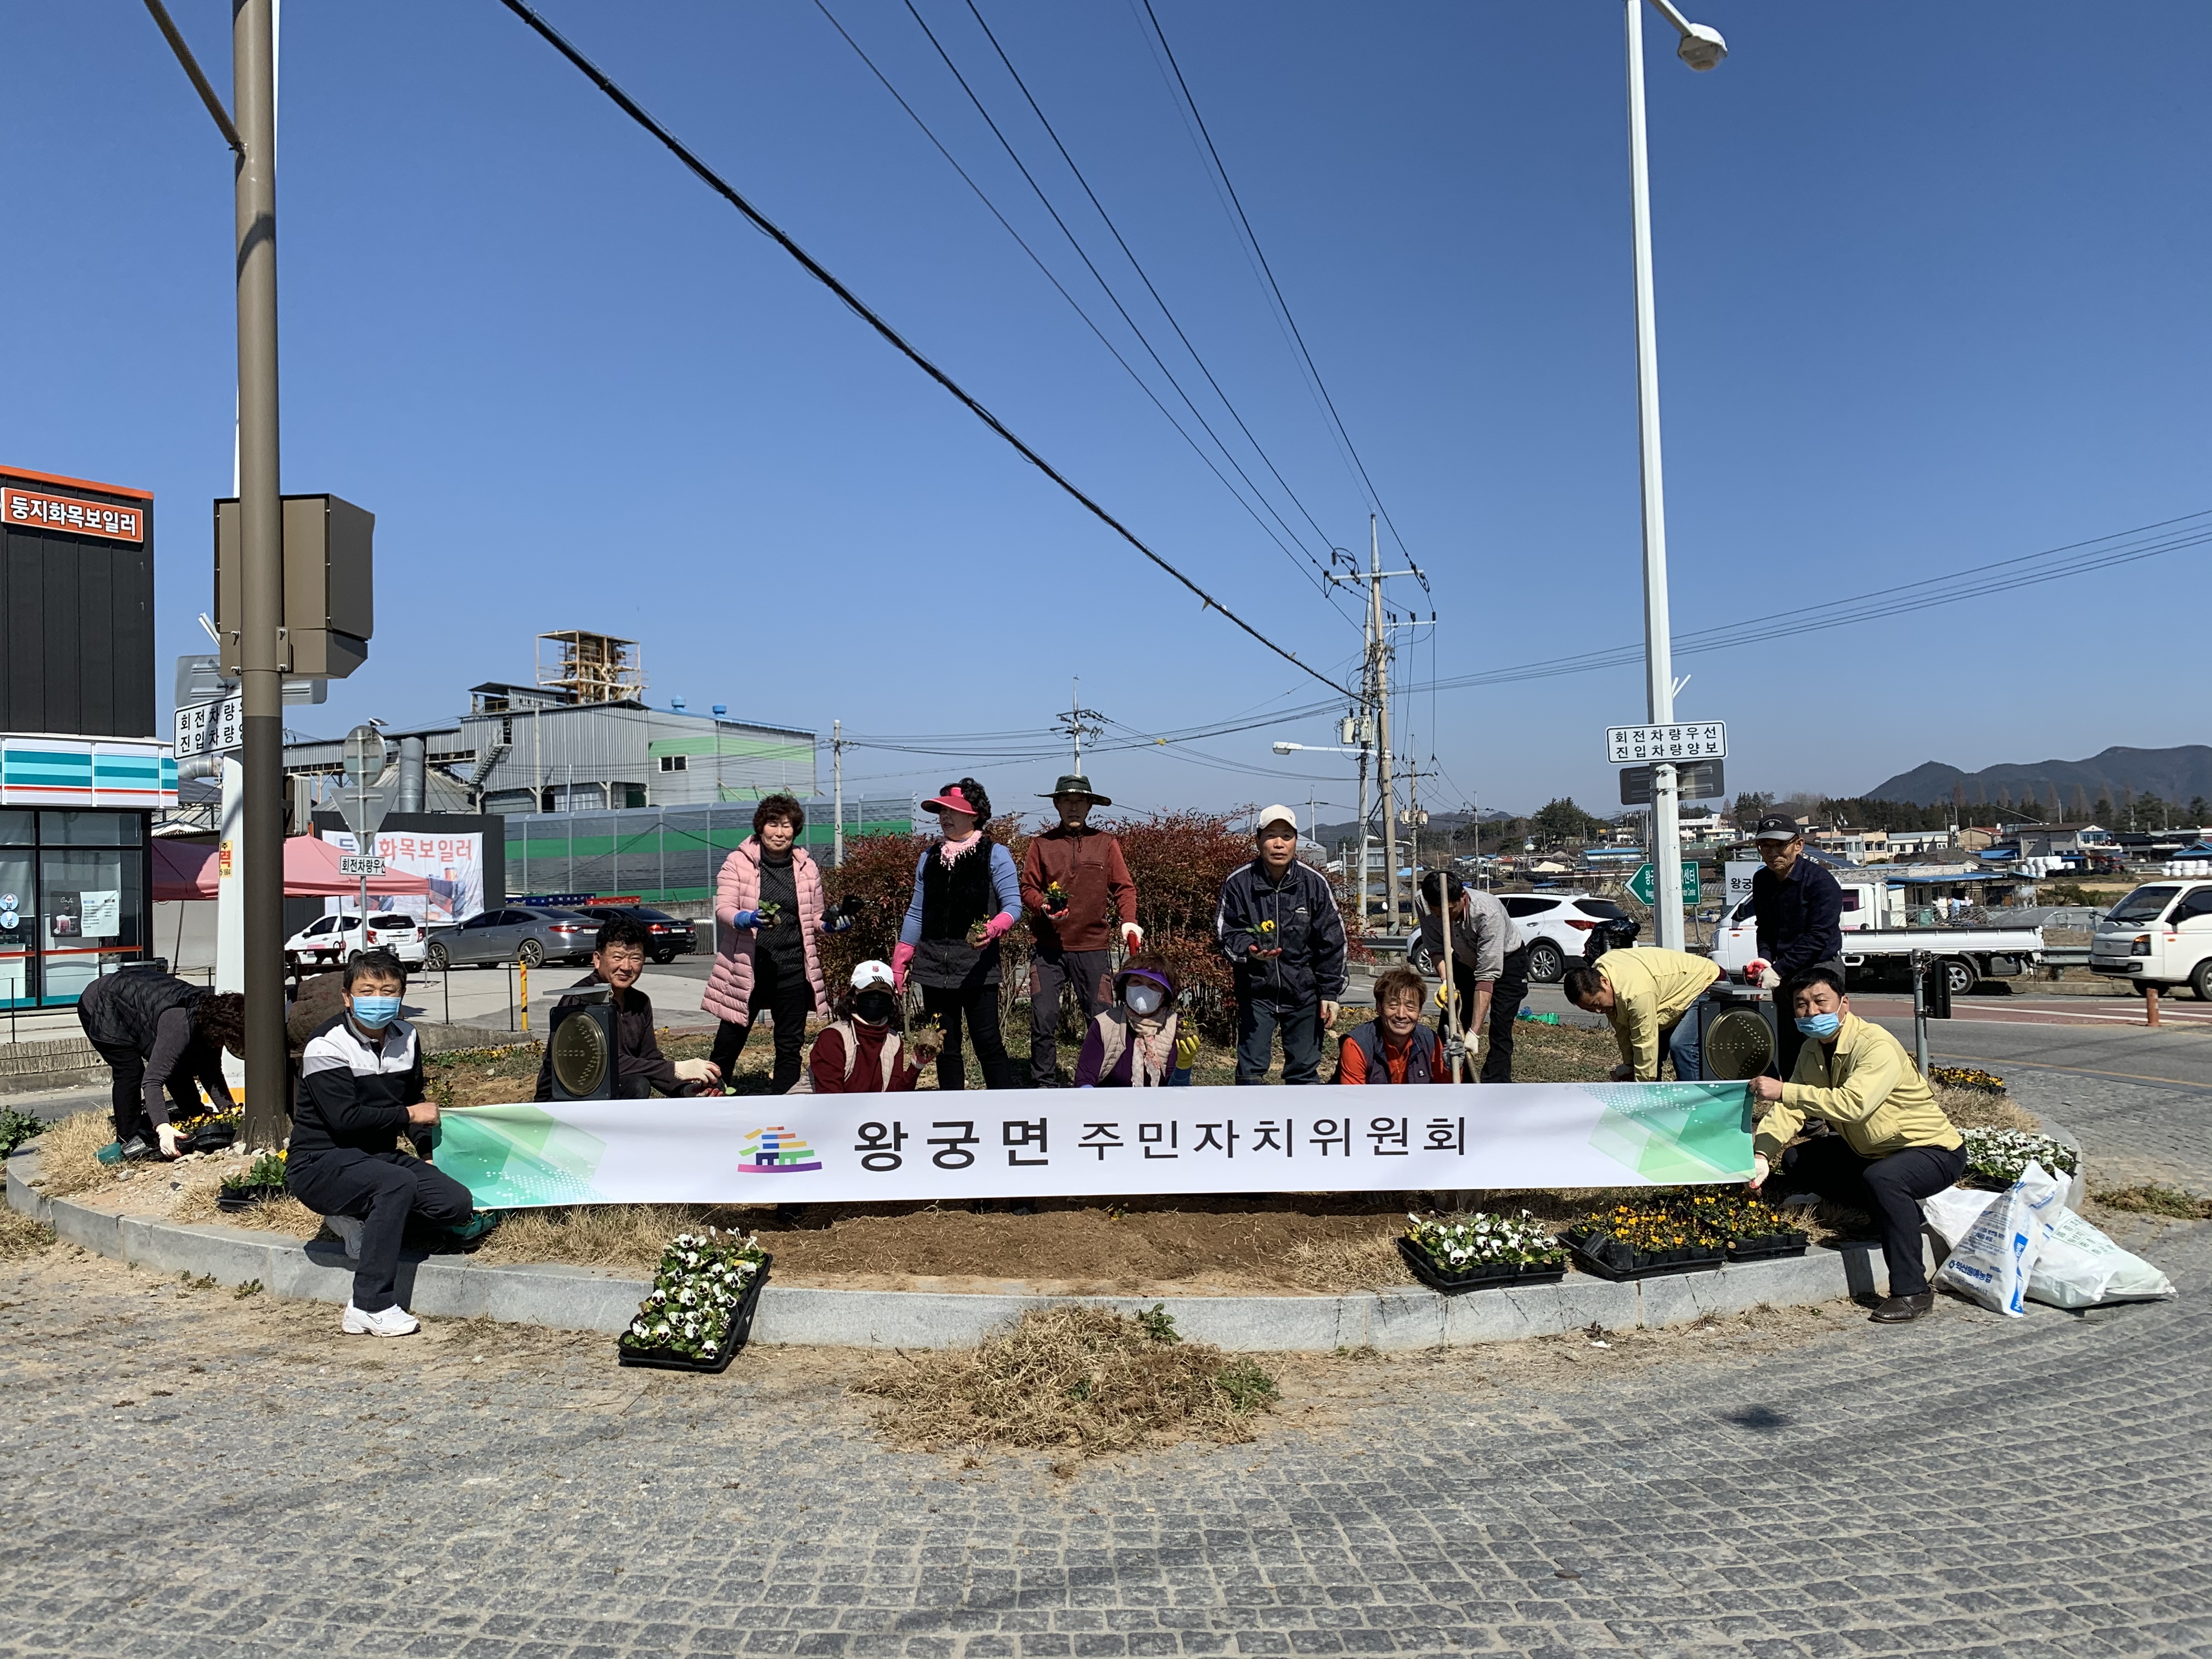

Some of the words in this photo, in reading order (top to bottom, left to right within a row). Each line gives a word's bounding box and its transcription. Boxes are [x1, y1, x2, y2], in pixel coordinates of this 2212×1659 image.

[10, 496, 136, 537] 둥지화목보일러
[854, 1116, 1049, 1172] 왕궁면
[1077, 1115, 1466, 1161] 주민자치위원회
